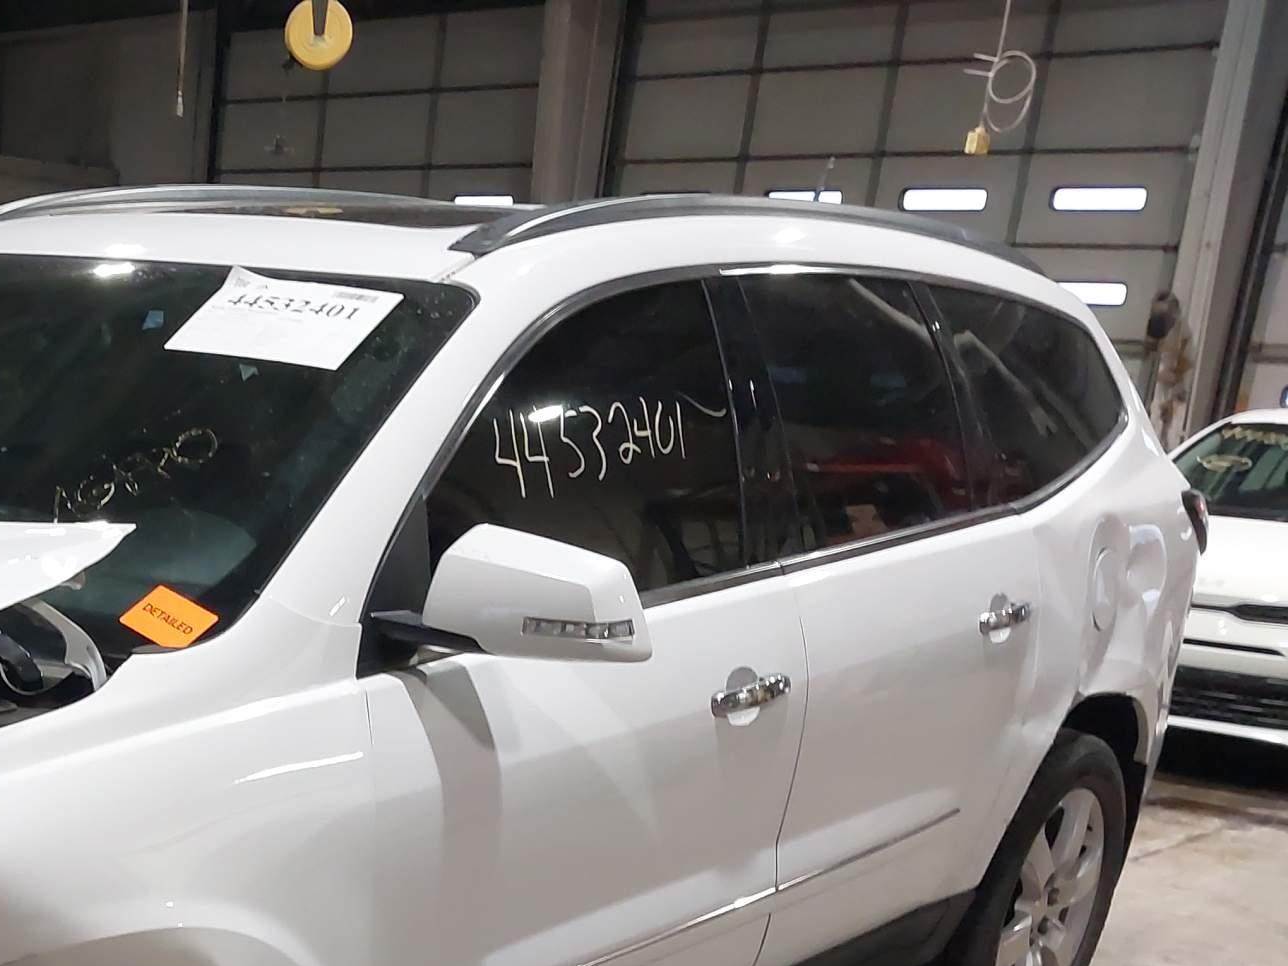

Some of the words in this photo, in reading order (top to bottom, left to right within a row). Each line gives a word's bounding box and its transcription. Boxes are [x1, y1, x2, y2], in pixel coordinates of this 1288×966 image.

[227, 293, 360, 321] 44532401
[494, 396, 686, 498] 44532401
[142, 603, 193, 635] DETAILED
